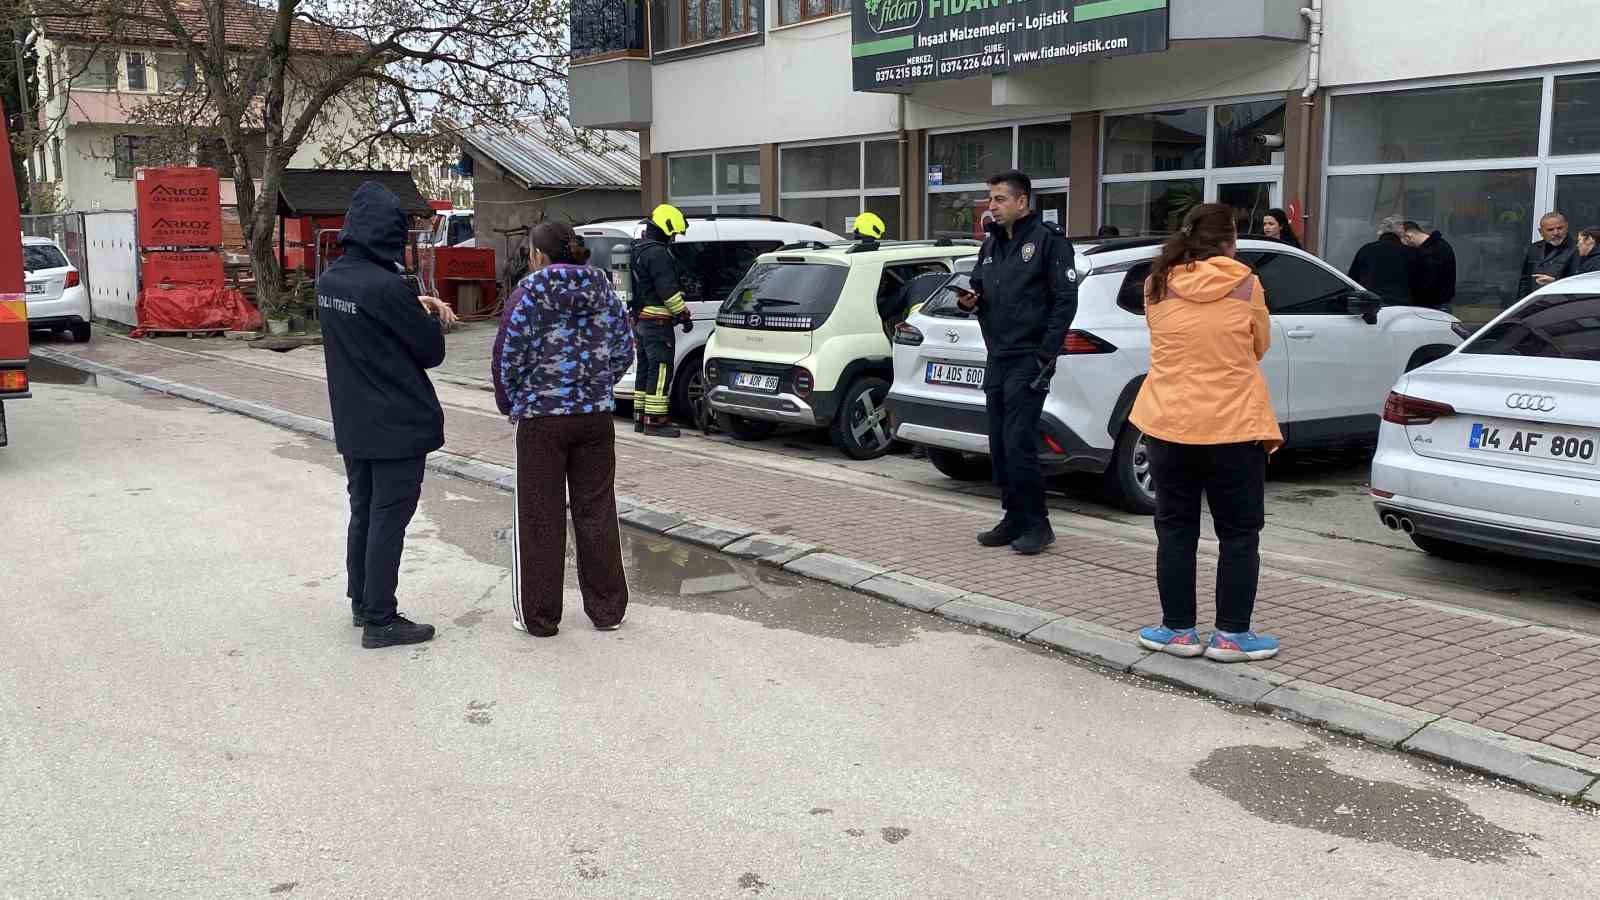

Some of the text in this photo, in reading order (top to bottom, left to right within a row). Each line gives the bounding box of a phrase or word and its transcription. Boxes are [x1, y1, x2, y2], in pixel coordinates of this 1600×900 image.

[877, 0, 918, 31] fidan
[918, 31, 948, 48] İnşaat
[949, 18, 1016, 42] Malzemeleri
[1025, 9, 1069, 31] Lojistik
[906, 54, 934, 66] MERKEZ:
[1013, 37, 1128, 63] www.fidanlojistik.com
[875, 64, 934, 82] 0374 215 88 27
[941, 53, 1005, 73] 0374 226 40 41
[933, 365, 983, 384] 14 ADS 600
[1481, 428, 1594, 460] 14 AF 800
